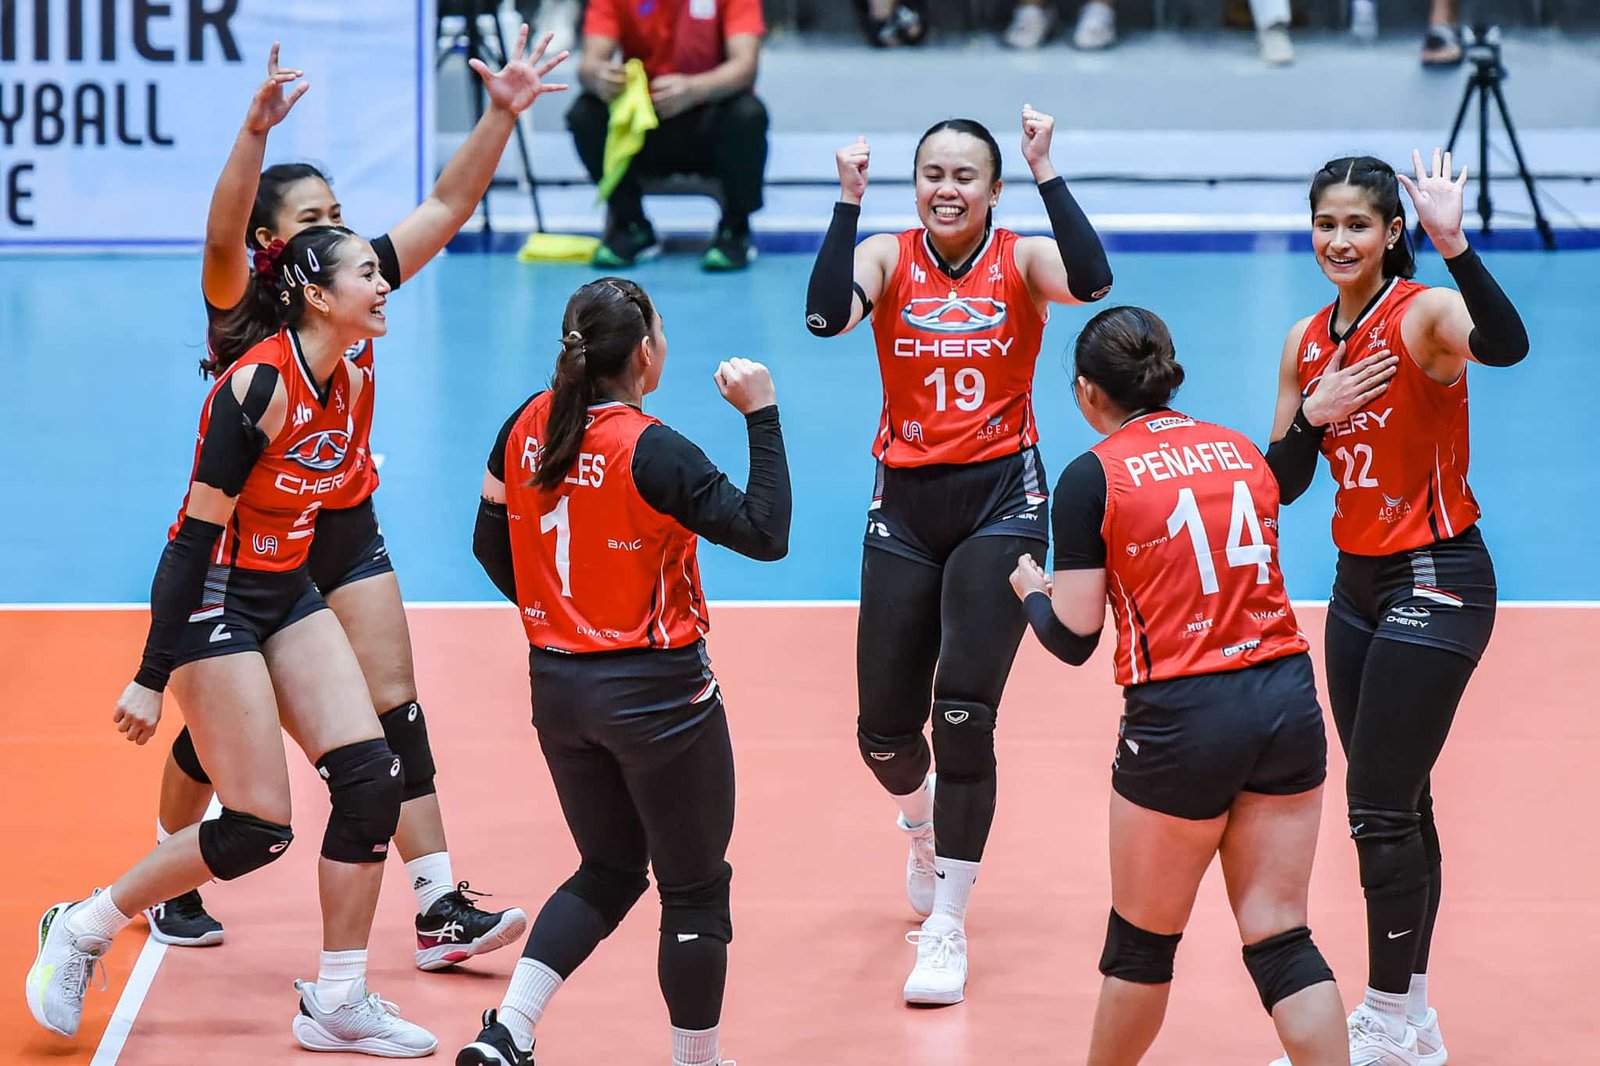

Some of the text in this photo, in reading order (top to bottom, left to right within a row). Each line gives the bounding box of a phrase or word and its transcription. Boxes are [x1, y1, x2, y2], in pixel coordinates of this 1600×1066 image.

[0, 82, 174, 146] YBALL
[894, 336, 1014, 358] CHERY
[924, 366, 986, 412] 19
[521, 435, 606, 489] RES
[1123, 440, 1254, 488] PEÑAFIEL
[1335, 442, 1379, 490] 22
[252, 532, 278, 556] UA
[539, 494, 573, 599] 1
[1166, 479, 1272, 596] 14
[524, 606, 547, 620] MUTT
[1186, 618, 1213, 633] MUTT
[1386, 614, 1429, 628] CHERY
